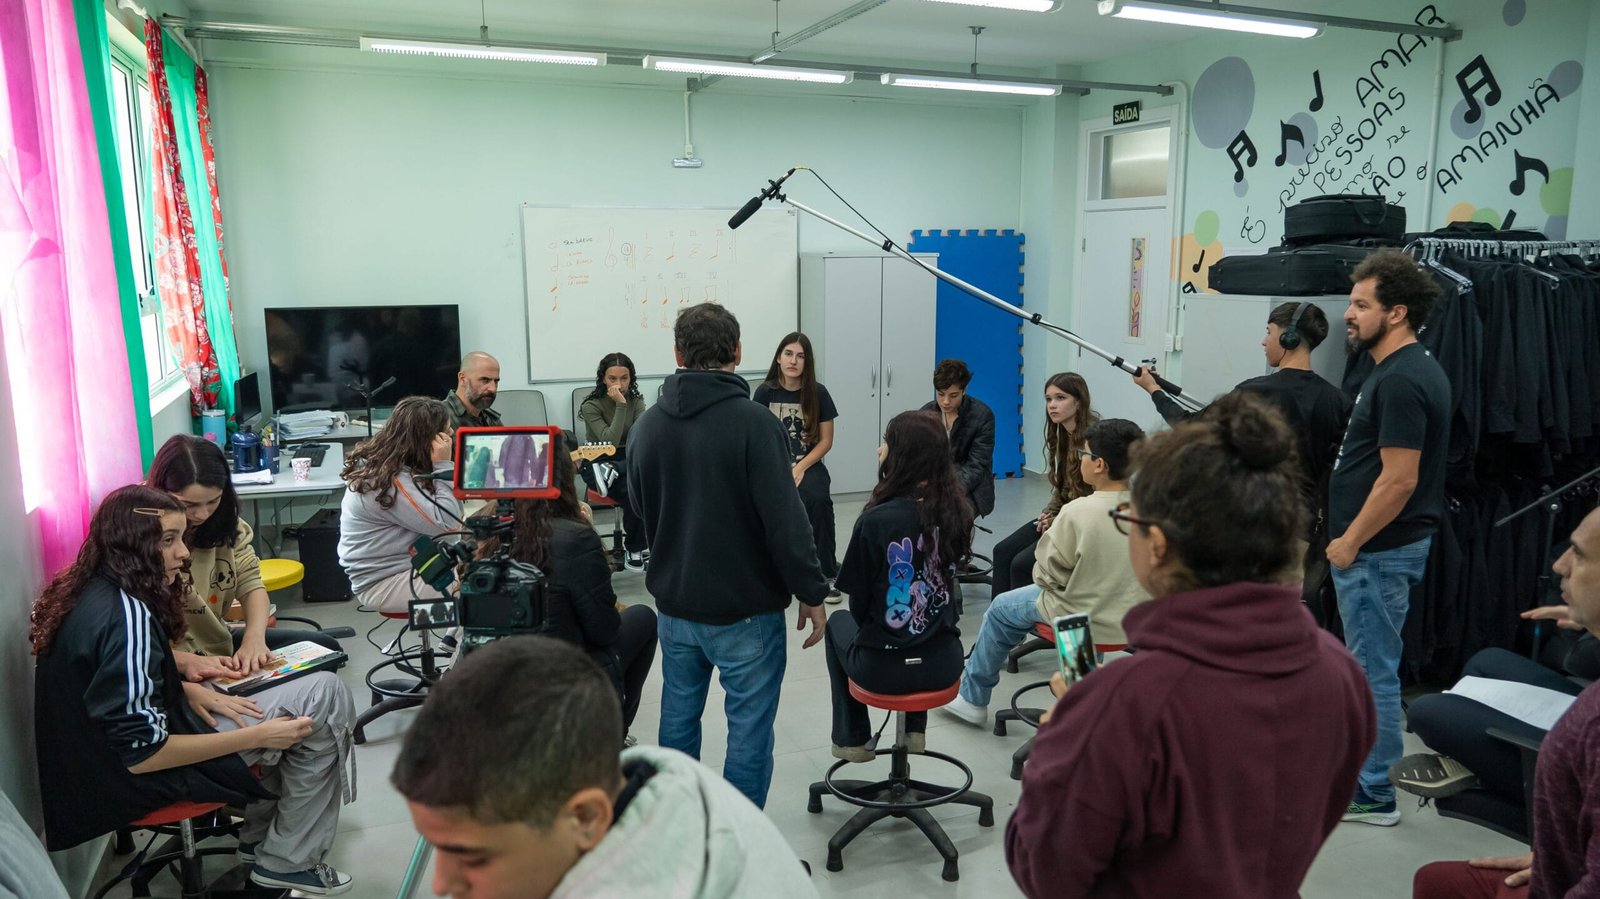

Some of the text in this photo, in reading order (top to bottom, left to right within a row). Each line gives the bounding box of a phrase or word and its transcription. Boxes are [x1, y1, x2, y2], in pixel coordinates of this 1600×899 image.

[1114, 105, 1139, 123] SAÍDA
[1278, 115, 1344, 214] preciso
[1355, 4, 1445, 109] AMAR
[1313, 86, 1406, 195] PESSOAS
[1436, 77, 1561, 195] AMANHÃ
[1361, 155, 1406, 197] ÃO
